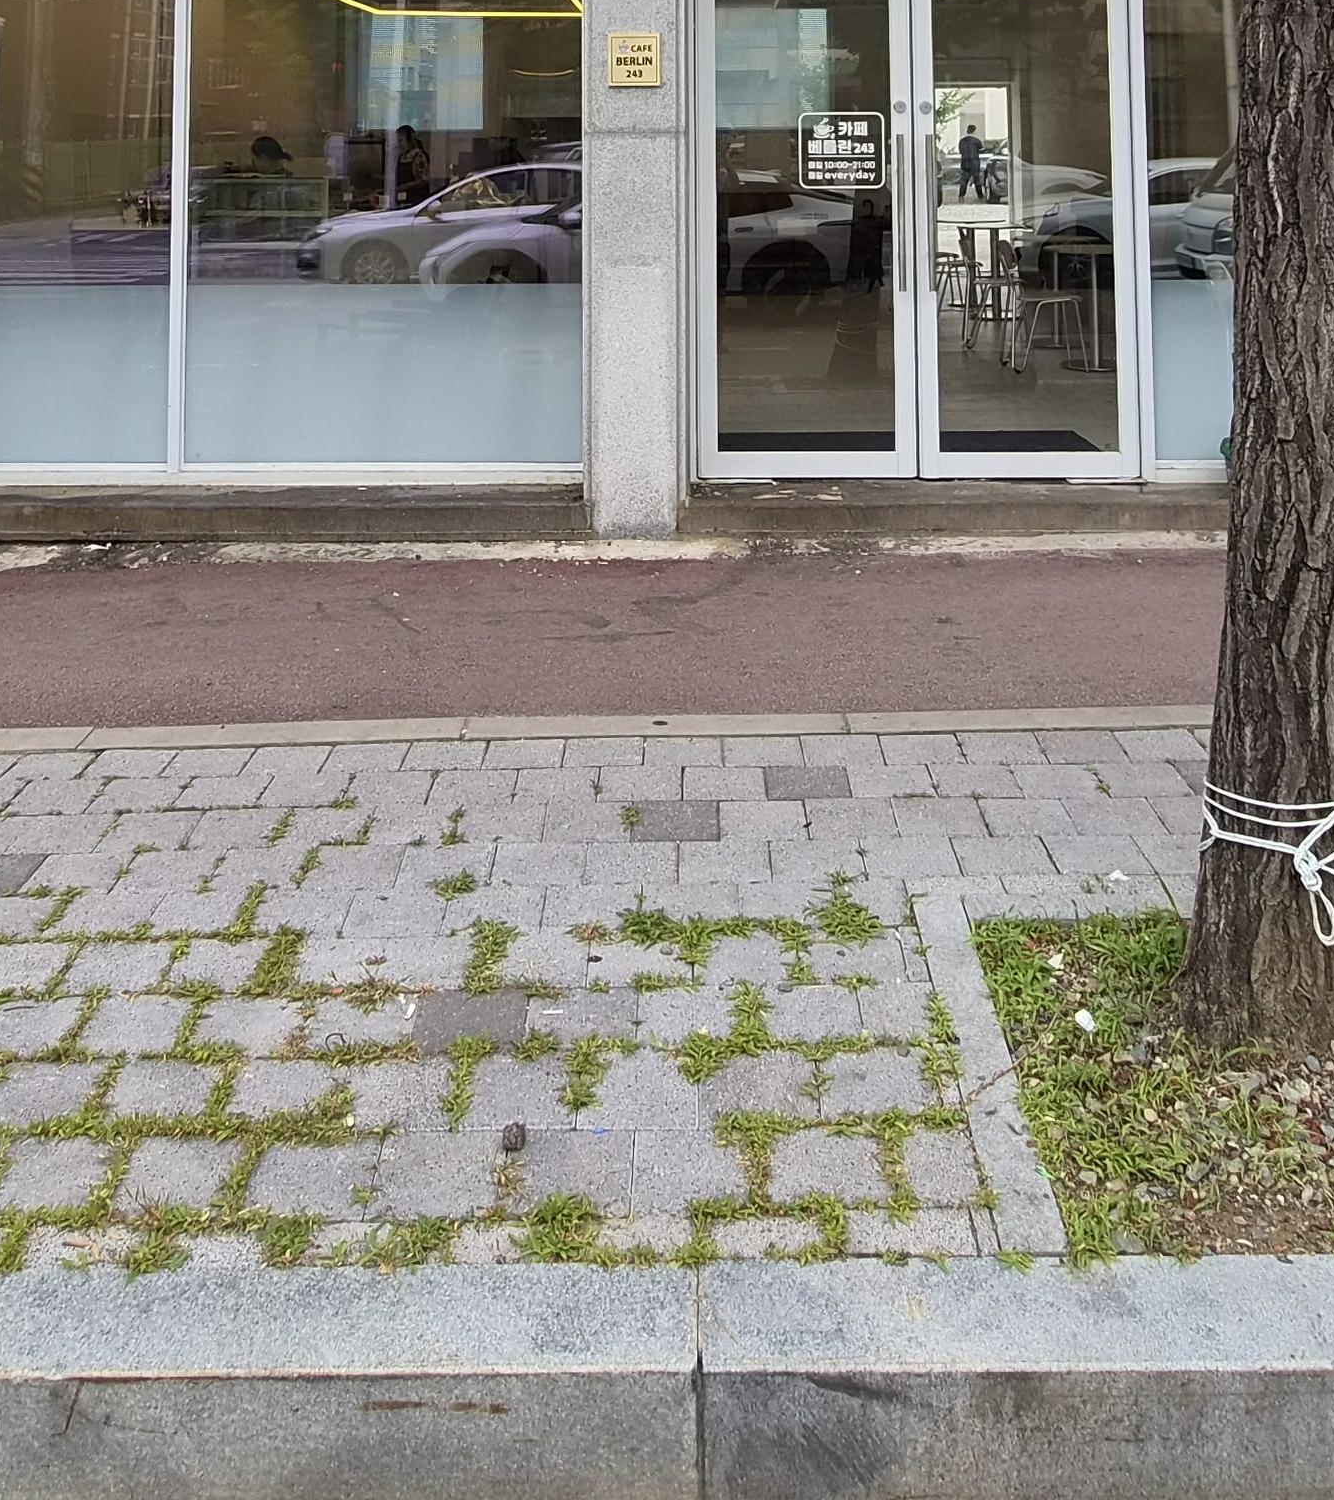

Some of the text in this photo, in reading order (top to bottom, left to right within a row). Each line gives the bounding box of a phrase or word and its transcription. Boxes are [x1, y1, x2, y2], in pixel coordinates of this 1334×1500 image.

[630, 44, 653, 53] CAFE
[616, 56, 653, 67] BERLIN
[626, 69, 643, 79] 243
[838, 120, 869, 137] 카페
[853, 142, 875, 154] 243
[824, 169, 876, 182] everyday
